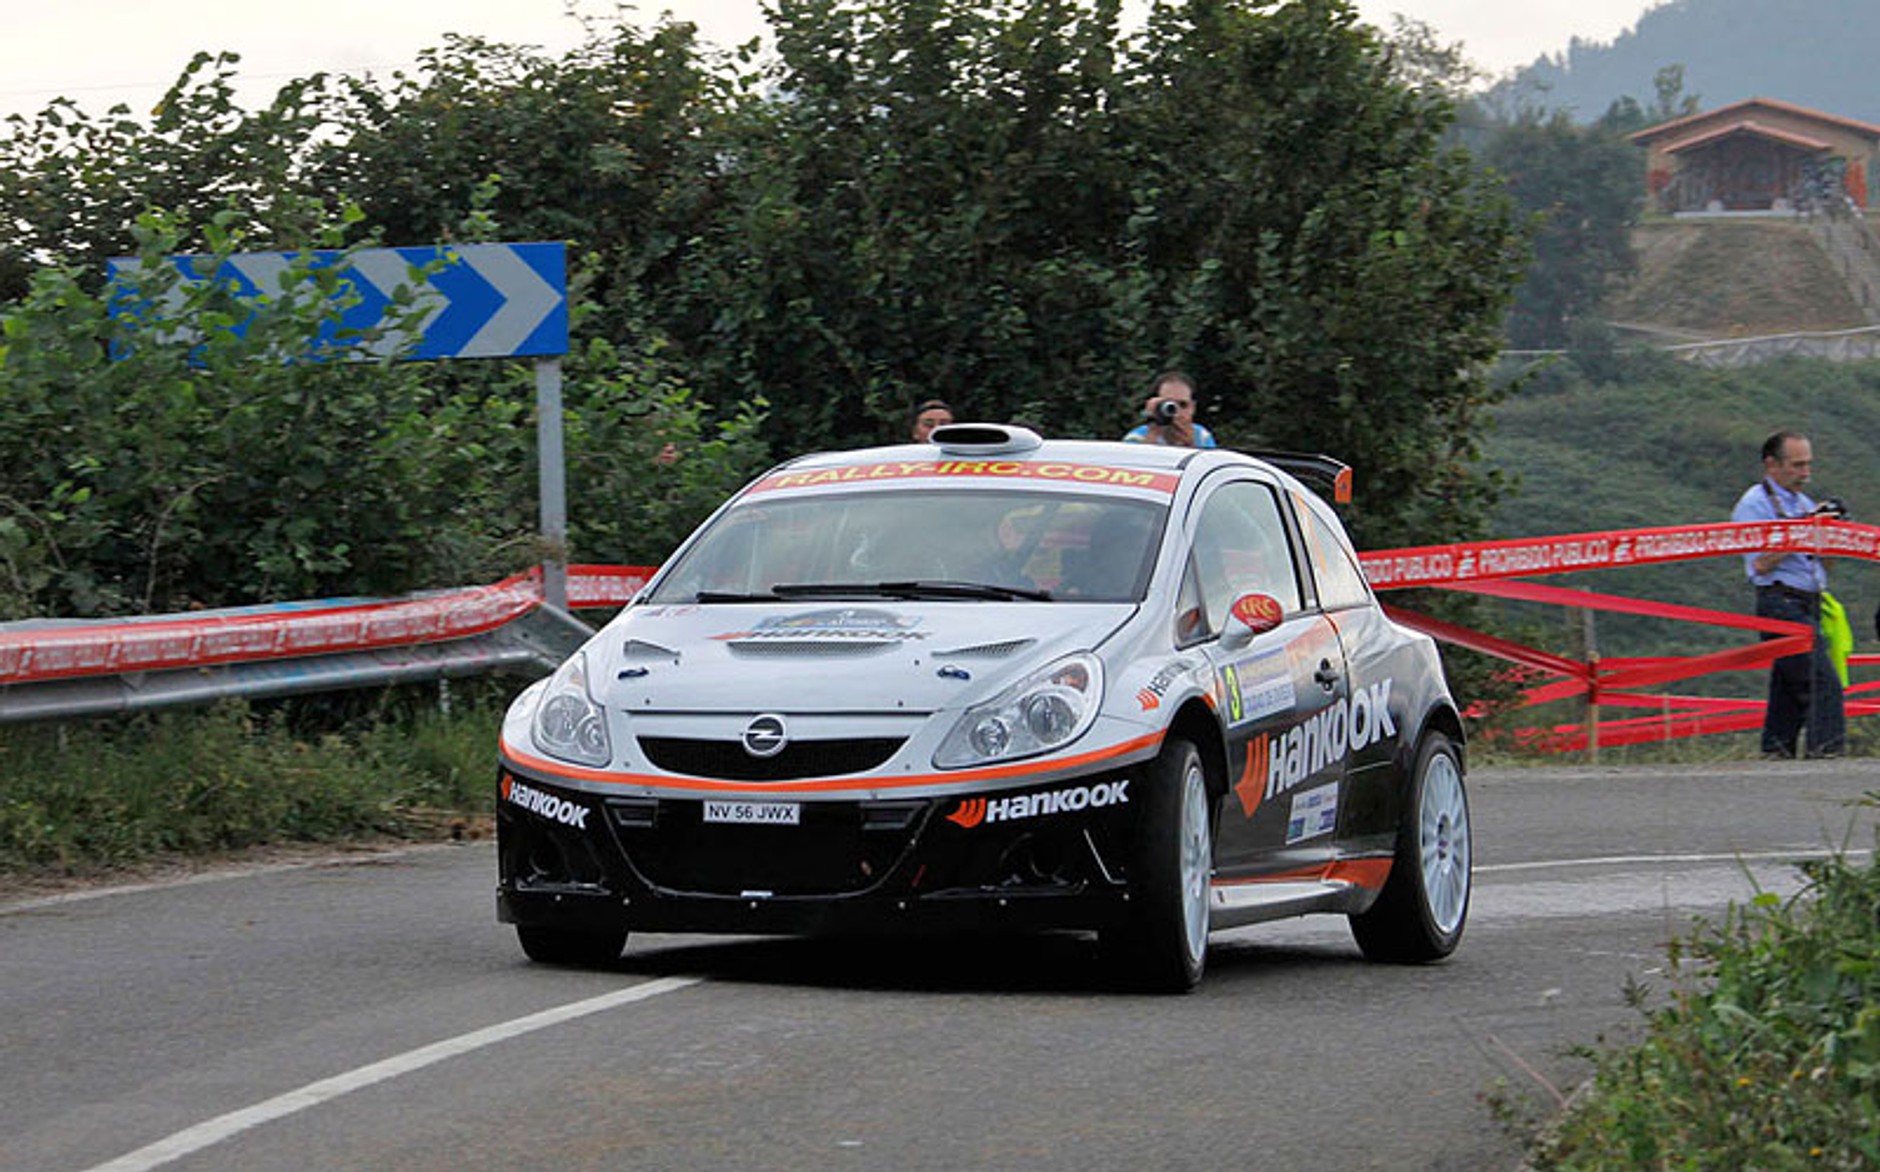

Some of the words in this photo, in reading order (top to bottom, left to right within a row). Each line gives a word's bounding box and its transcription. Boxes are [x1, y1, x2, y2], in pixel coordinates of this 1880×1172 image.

[775, 461, 1155, 487] RALLY-IRC.COM
[1240, 597, 1278, 621] IRC
[1225, 665, 1241, 722] 3
[709, 804, 731, 819] NV
[735, 805, 753, 819] 56
[757, 806, 793, 820] JWX
